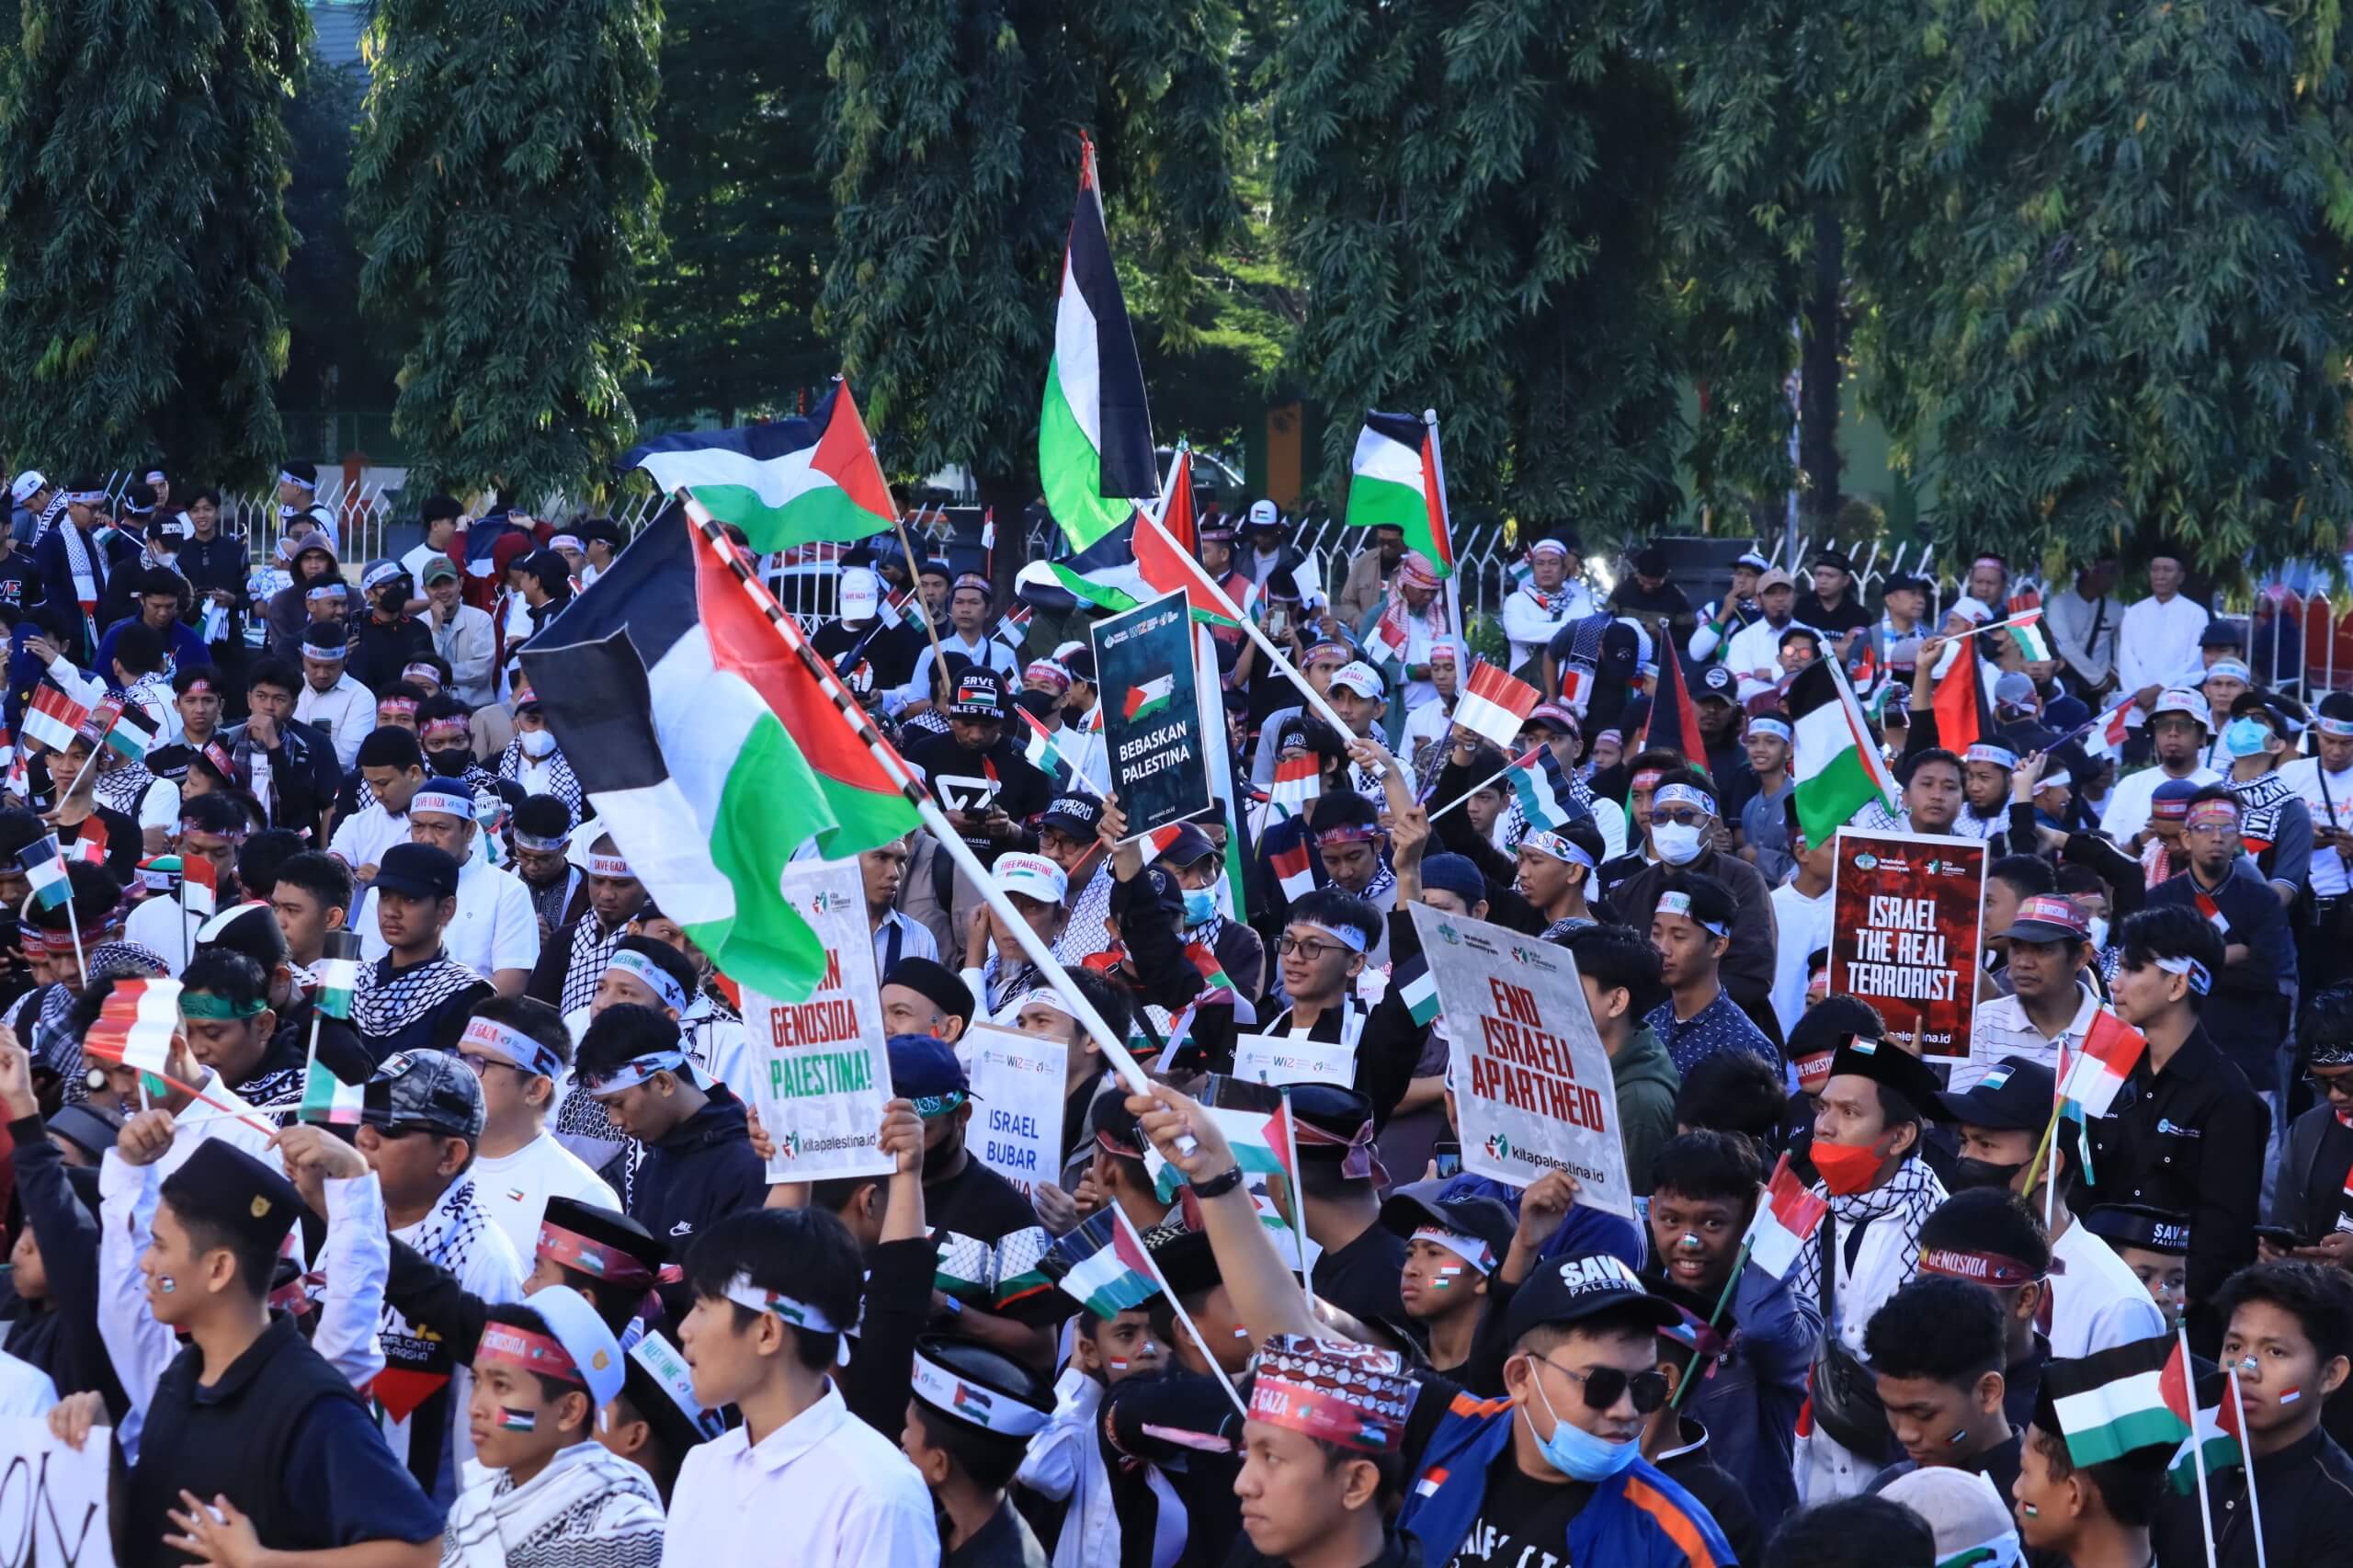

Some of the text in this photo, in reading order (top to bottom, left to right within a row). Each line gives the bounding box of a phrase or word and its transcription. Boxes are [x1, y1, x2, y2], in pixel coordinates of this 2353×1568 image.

[963, 676, 995, 687] SAVE
[949, 704, 1005, 719] PALESTIN
[1120, 720, 1188, 762] BEBASKAN
[1122, 744, 1190, 785] PALESTINA
[594, 858, 627, 872] SAVE GAZA
[1000, 858, 1052, 878] FREE PALESTINE
[1869, 895, 1937, 932] ISRAEL
[1856, 929, 1947, 967] THE REAL
[1847, 962, 1958, 1001] TERRORIST
[1488, 976, 1543, 1029] END
[476, 1022, 498, 1044] GAZA
[770, 999, 860, 1048] GENOSIDA
[1480, 1014, 1575, 1080] ISRAELI
[770, 1049, 873, 1100] PALESTINA!
[1471, 1054, 1605, 1133] APARTHEID
[989, 1108, 1040, 1140] ISRAEL
[801, 1132, 877, 1154] kitapalestina.id
[986, 1140, 1037, 1172] BUBAR
[1511, 1145, 1605, 1184] kitapalestina.id
[1928, 1249, 1988, 1278] GENOSIDA
[1568, 1280, 1647, 1298] PALESTIN
[1259, 1388, 1290, 1416] GAZA
